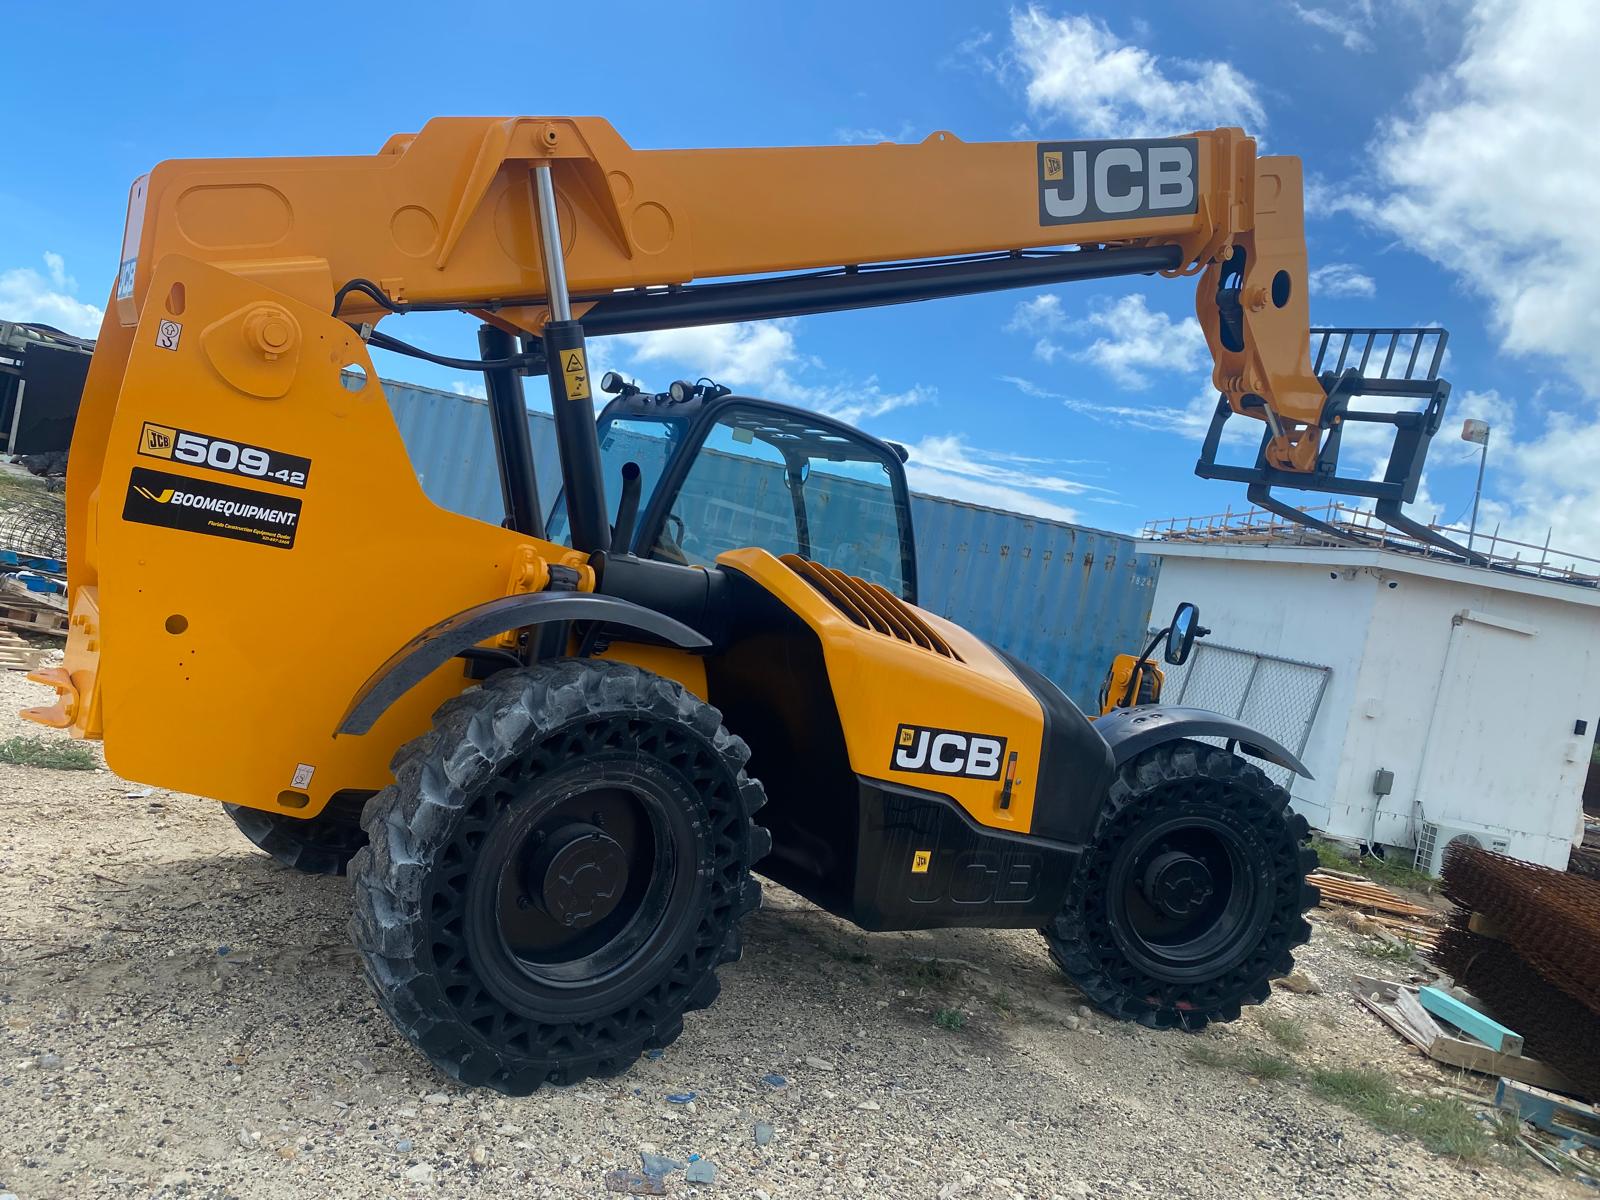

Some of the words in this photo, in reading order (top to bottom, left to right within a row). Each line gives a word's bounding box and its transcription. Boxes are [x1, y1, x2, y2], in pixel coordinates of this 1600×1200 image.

[1044, 147, 1194, 217] JCB
[149, 432, 170, 448] JCB
[896, 730, 1001, 777] JCB
